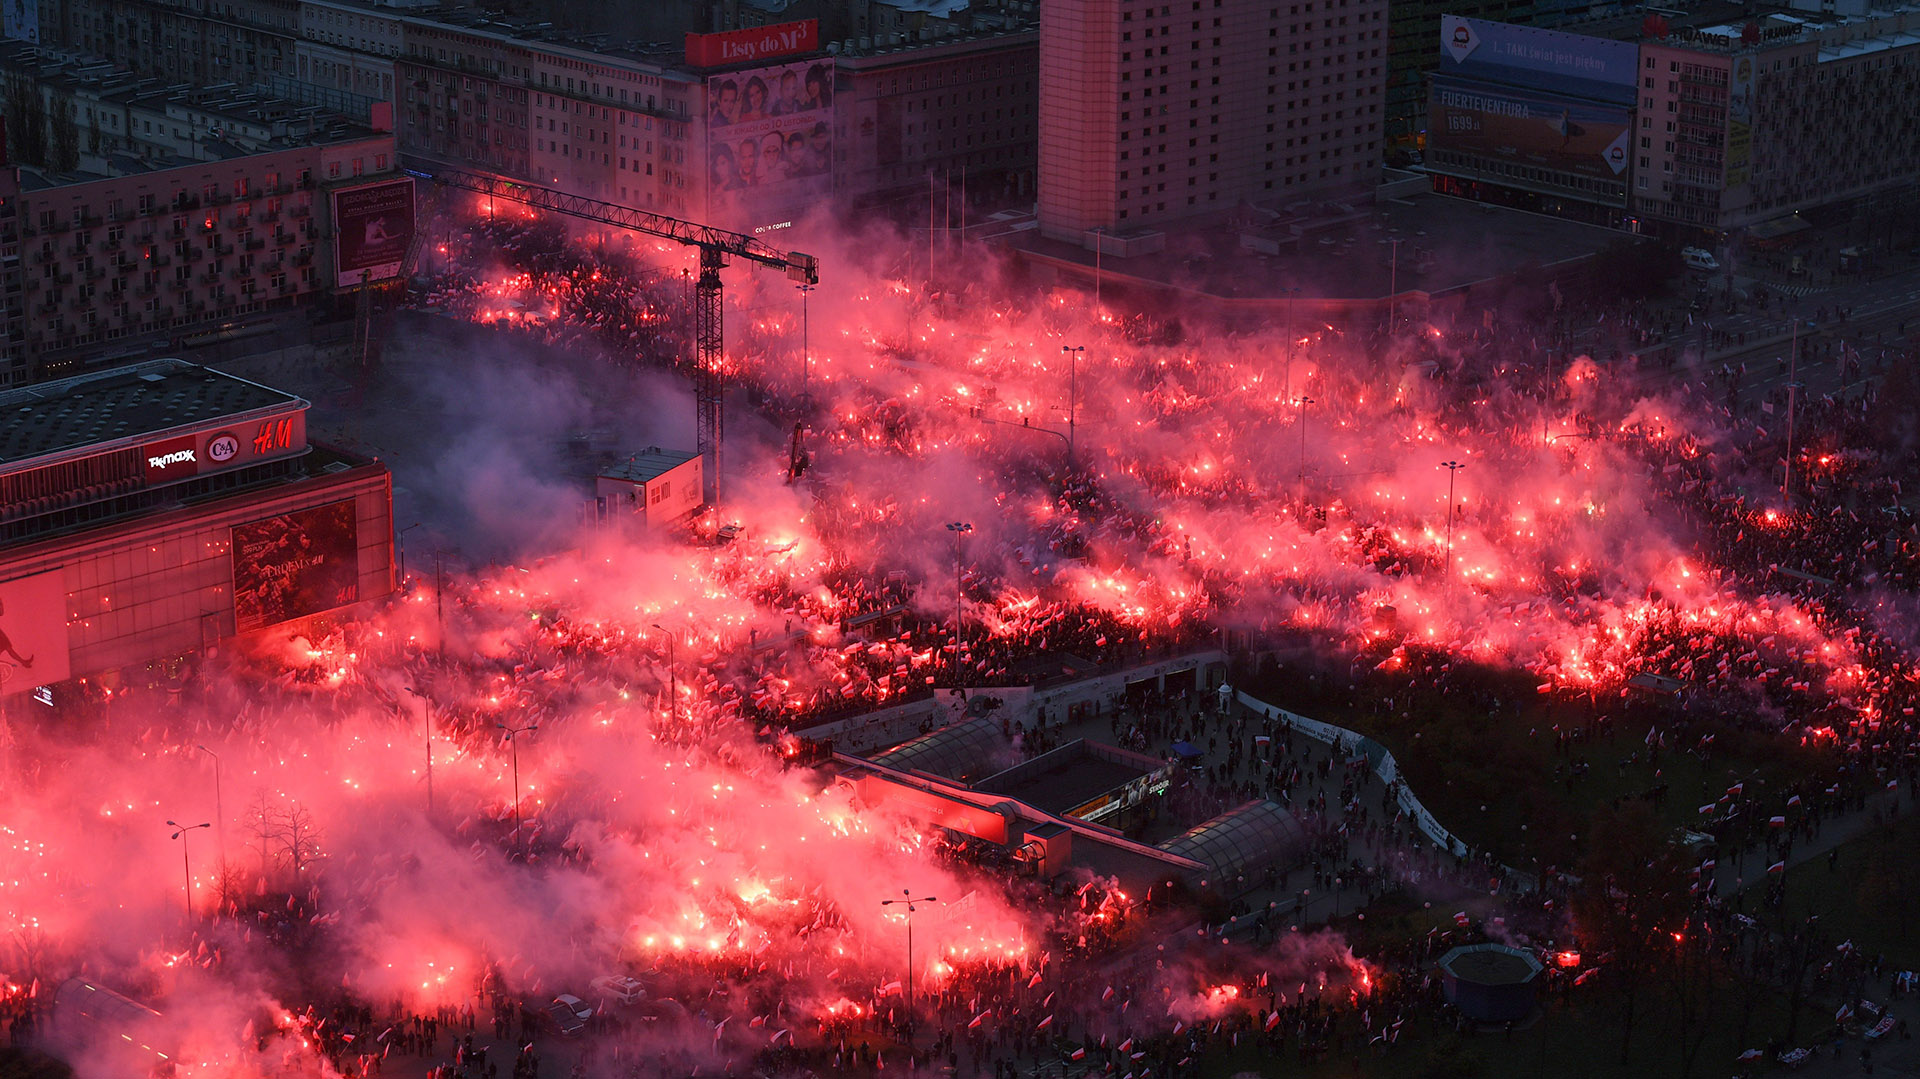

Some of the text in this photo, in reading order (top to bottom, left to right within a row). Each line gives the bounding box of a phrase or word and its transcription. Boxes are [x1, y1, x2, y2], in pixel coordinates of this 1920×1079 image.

[722, 40, 756, 59] Listy
[760, 36, 779, 51] do
[1506, 42, 1527, 56] TAKI
[1529, 46, 1554, 62] świat
[1555, 50, 1573, 65] jest
[1575, 53, 1606, 72] piękny
[1441, 91, 1529, 119] FUERTEVENTURA
[760, 122, 770, 131] OD
[771, 118, 782, 129] 10
[783, 115, 817, 127] LISTOPADA
[1447, 115, 1473, 130] 1699
[772, 221, 791, 230] COFFEE
[253, 418, 292, 454] H&M
[212, 440, 235, 457] C&A
[267, 559, 304, 578] ERDEM
